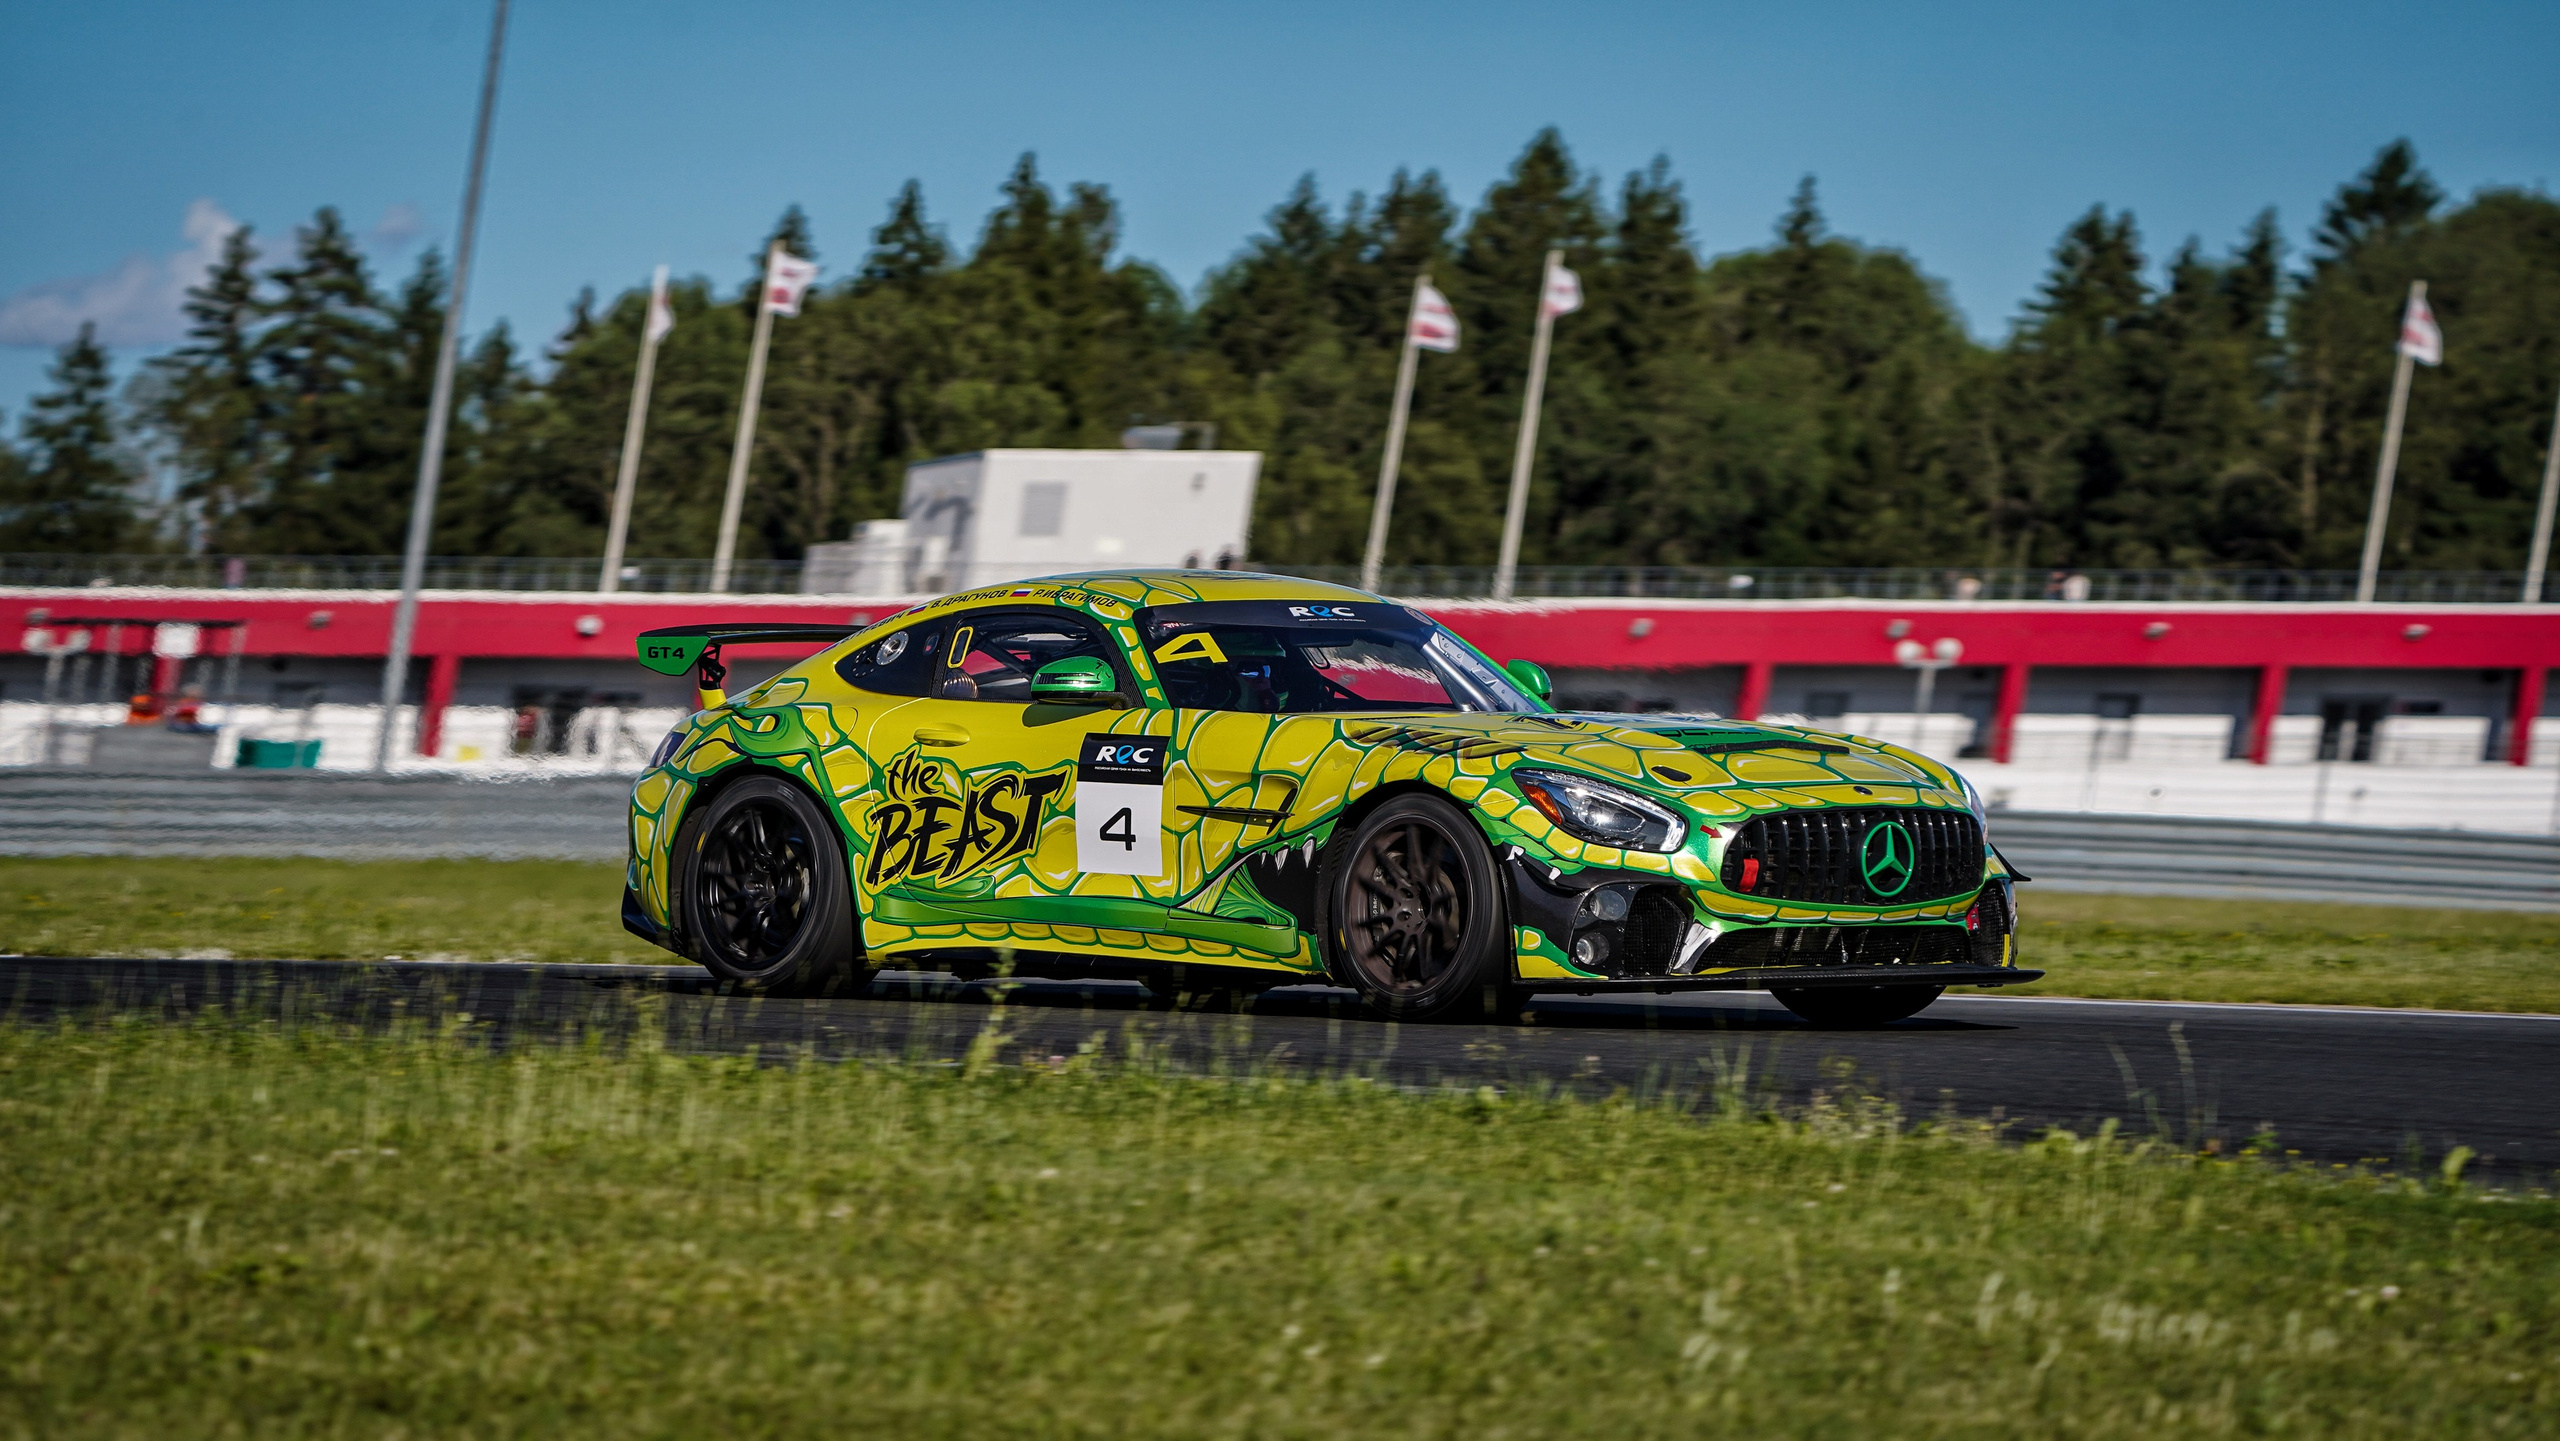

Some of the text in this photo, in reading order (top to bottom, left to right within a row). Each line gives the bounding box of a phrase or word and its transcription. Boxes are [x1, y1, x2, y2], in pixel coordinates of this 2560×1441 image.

[648, 646, 685, 659] GT4
[1153, 632, 1229, 664] 4
[886, 748, 943, 800] the
[866, 770, 1068, 887] BEAST
[1099, 807, 1136, 851] 4
